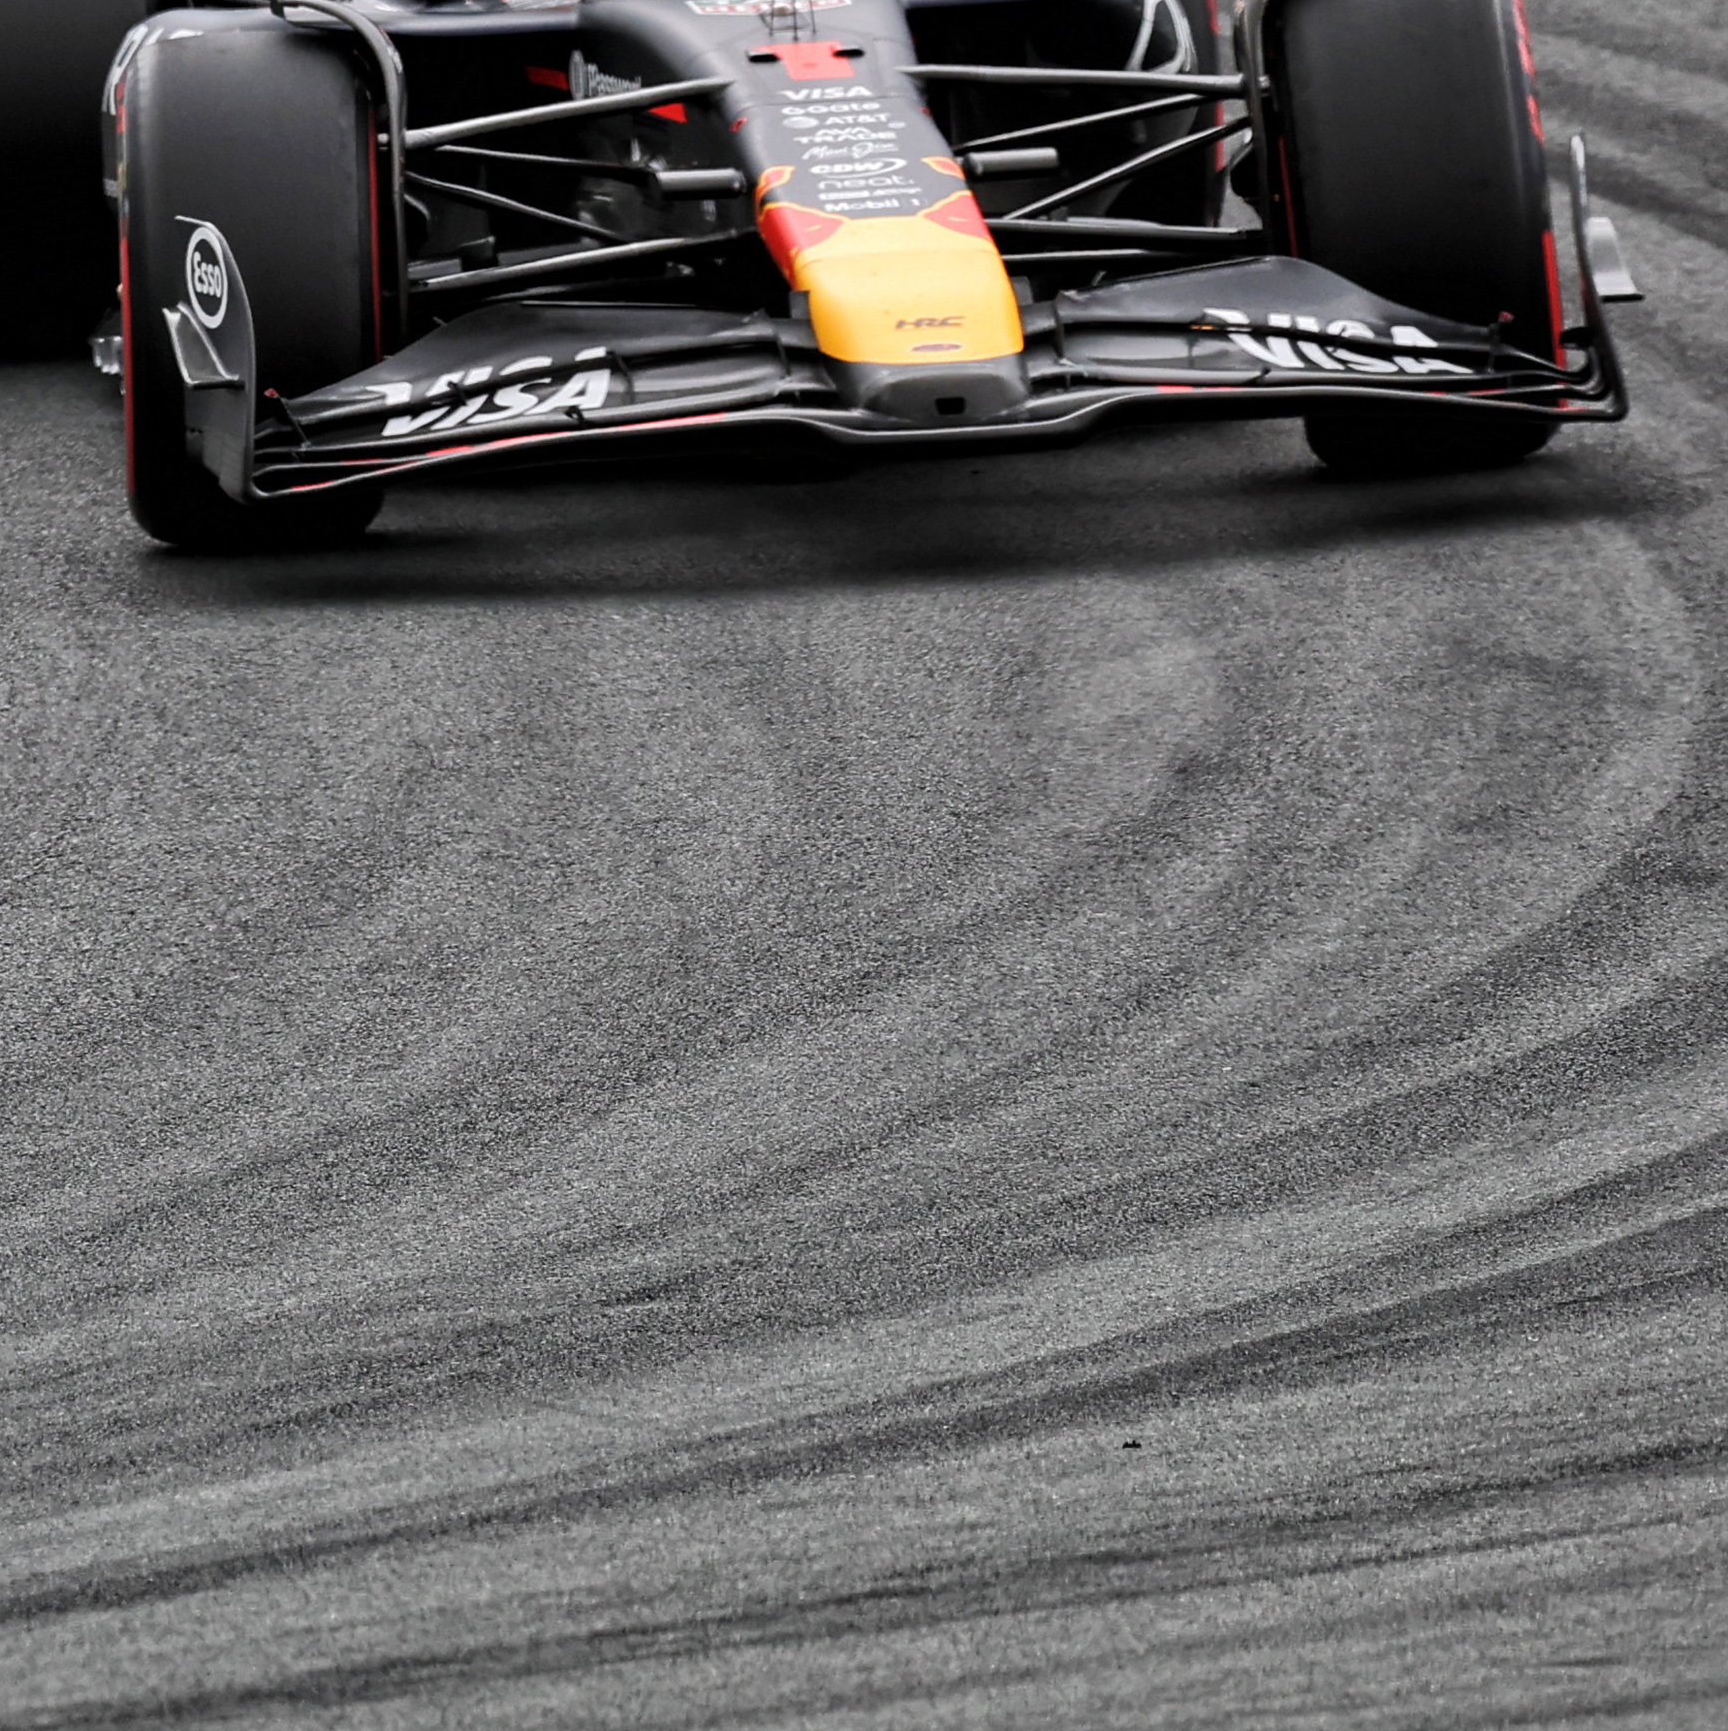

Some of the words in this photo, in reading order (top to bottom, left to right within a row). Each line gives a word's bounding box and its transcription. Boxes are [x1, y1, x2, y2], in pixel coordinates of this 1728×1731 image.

[777, 85, 873, 101] VISA
[1203, 307, 1474, 374] VISA
[365, 346, 611, 436] VISA
